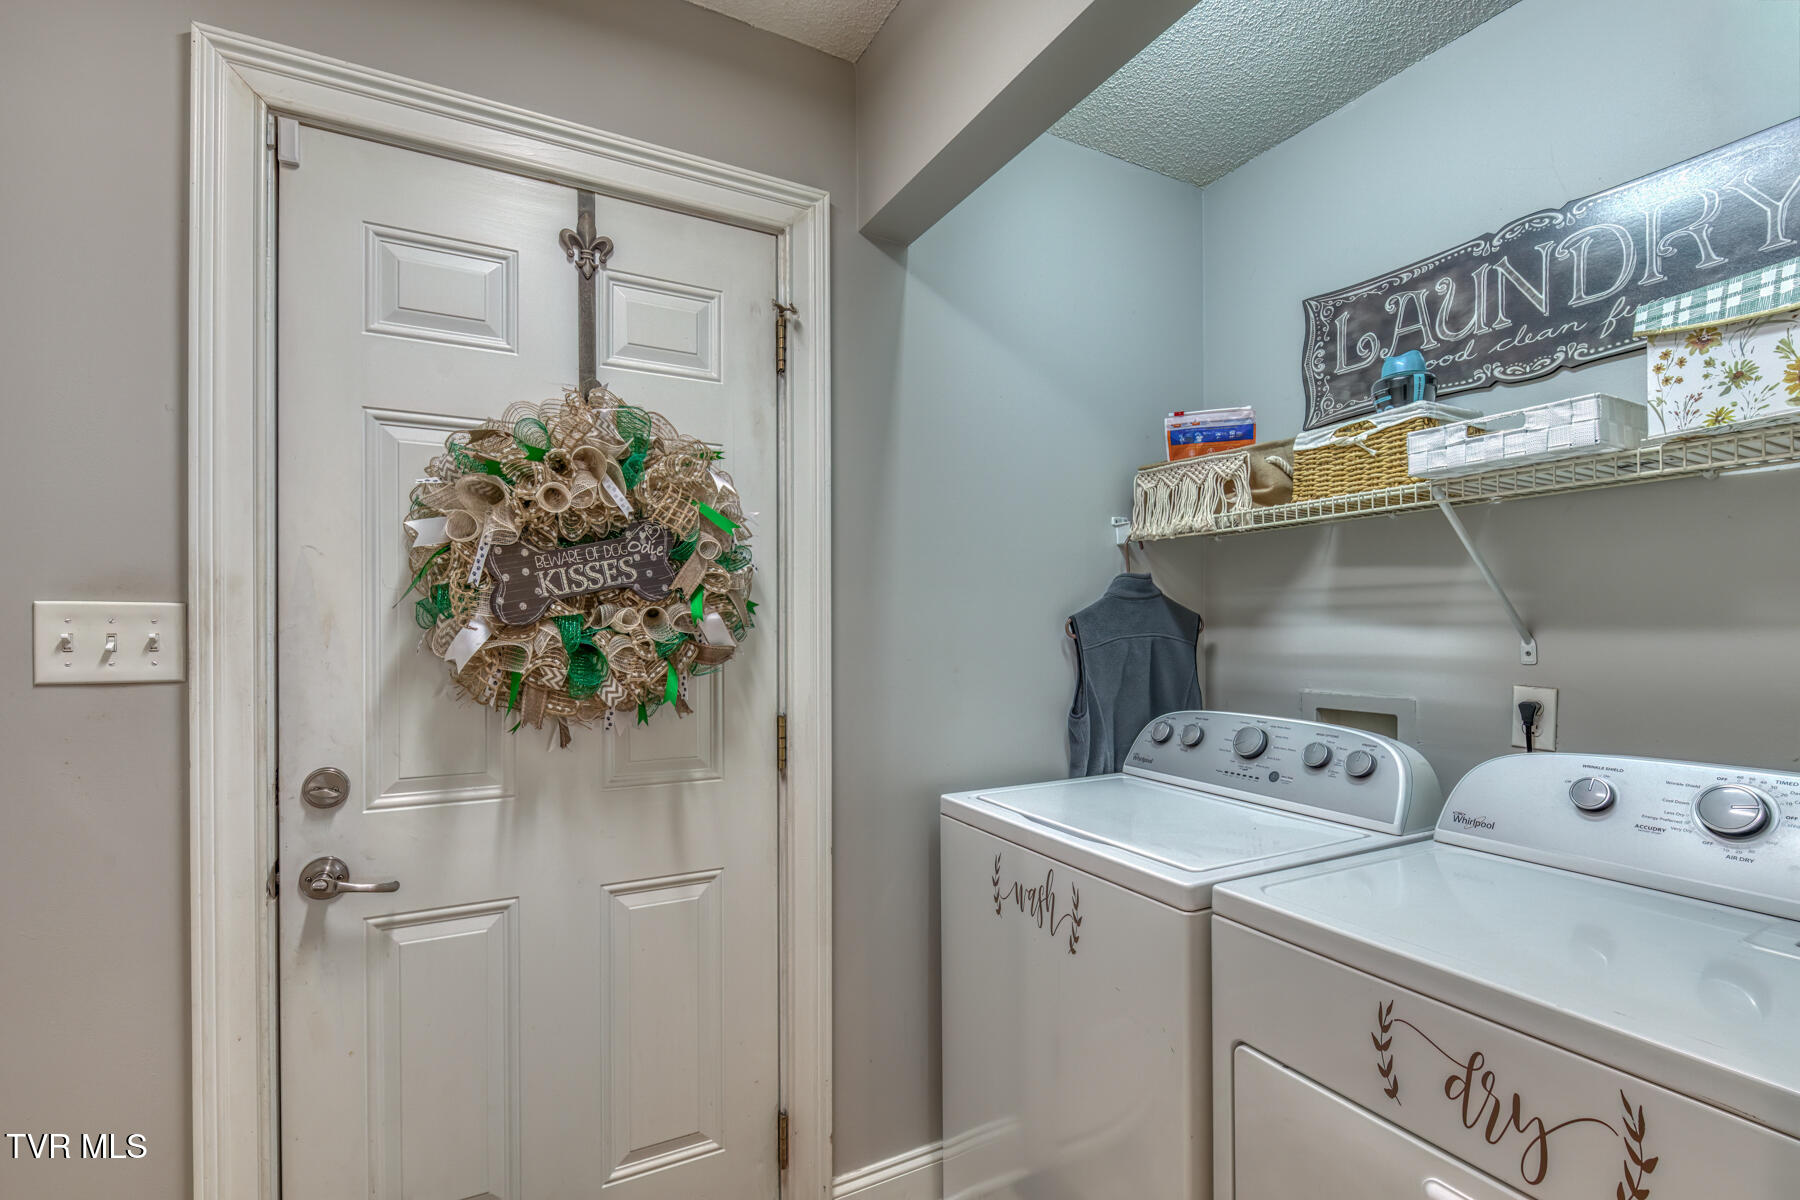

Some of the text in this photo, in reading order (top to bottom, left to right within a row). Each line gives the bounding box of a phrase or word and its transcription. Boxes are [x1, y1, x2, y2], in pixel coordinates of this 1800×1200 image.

[1334, 168, 1800, 376] LAUNDRY
[1425, 296, 1662, 371] ood clean fu
[534, 542, 628, 569] BEWARE OF DOG
[627, 540, 664, 556] Odie
[534, 556, 638, 598] KISSES
[1775, 779, 1800, 787] TIMED
[1452, 813, 1496, 830] Whirlpool
[1006, 868, 1063, 937] wash
[1442, 1050, 1562, 1187] dry
